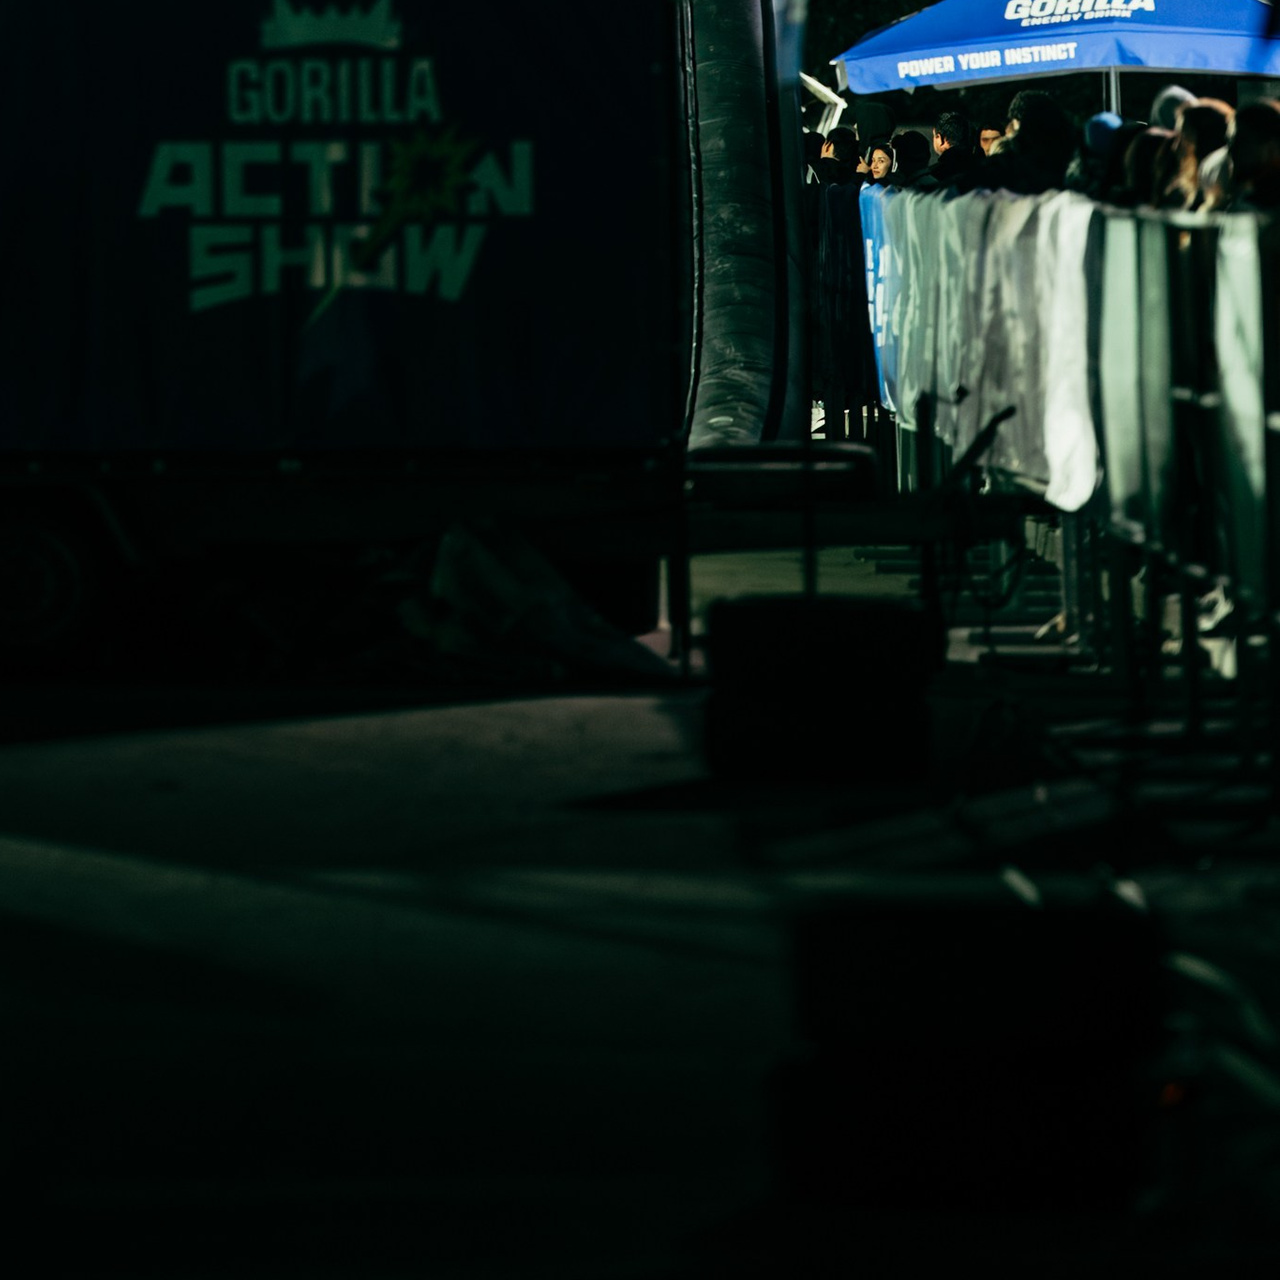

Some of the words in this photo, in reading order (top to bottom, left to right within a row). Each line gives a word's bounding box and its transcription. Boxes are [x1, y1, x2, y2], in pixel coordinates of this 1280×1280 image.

[226, 56, 444, 126] GORILLA
[897, 55, 955, 79] POWER
[958, 50, 1002, 71] YOUR
[1004, 42, 1078, 65] INSTINCT
[187, 223, 489, 314] SHOW
